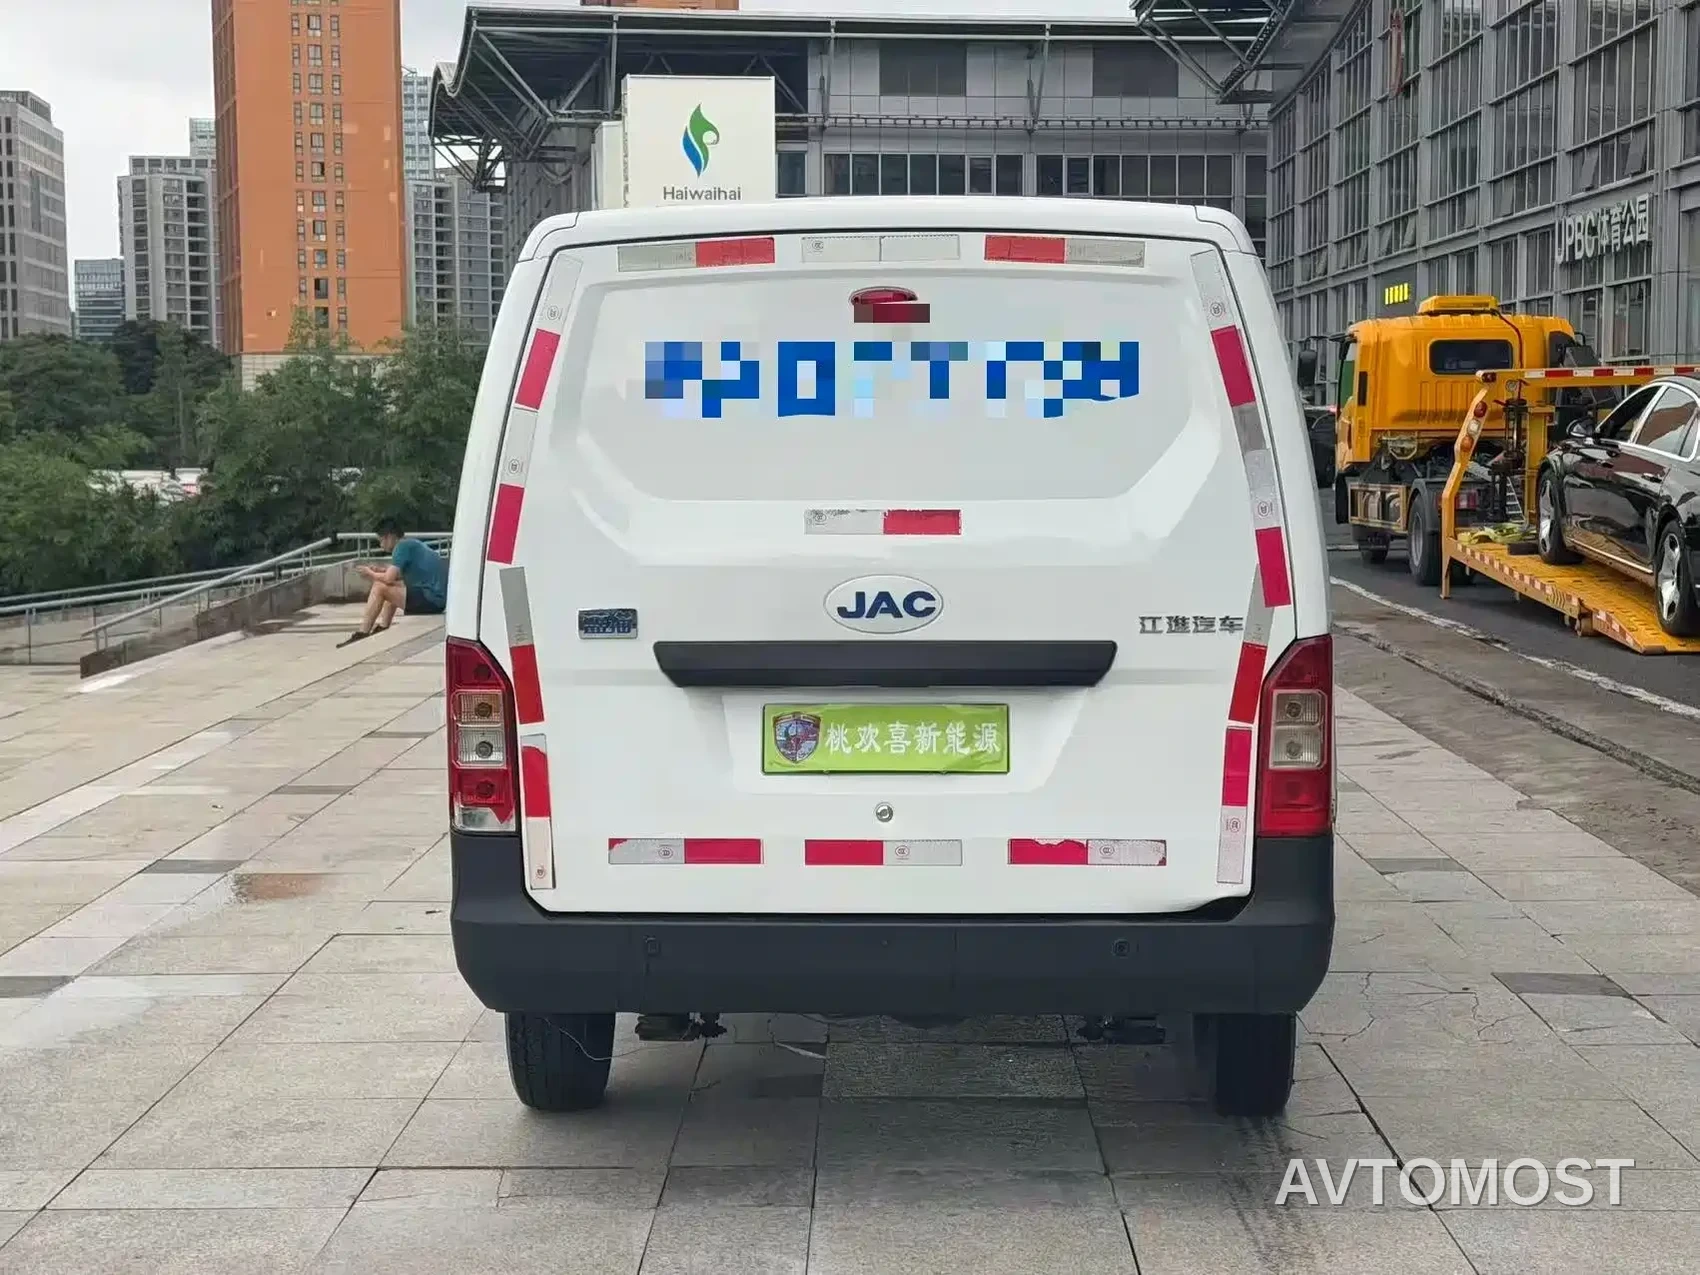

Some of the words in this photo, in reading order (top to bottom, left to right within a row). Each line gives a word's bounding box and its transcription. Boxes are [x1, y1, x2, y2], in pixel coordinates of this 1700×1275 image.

[662, 185, 742, 201] Haiwaihai
[837, 590, 937, 619] JAC
[1138, 615, 1244, 634] 江淮汽车
[824, 719, 1001, 756] 桃欢喜新能源
